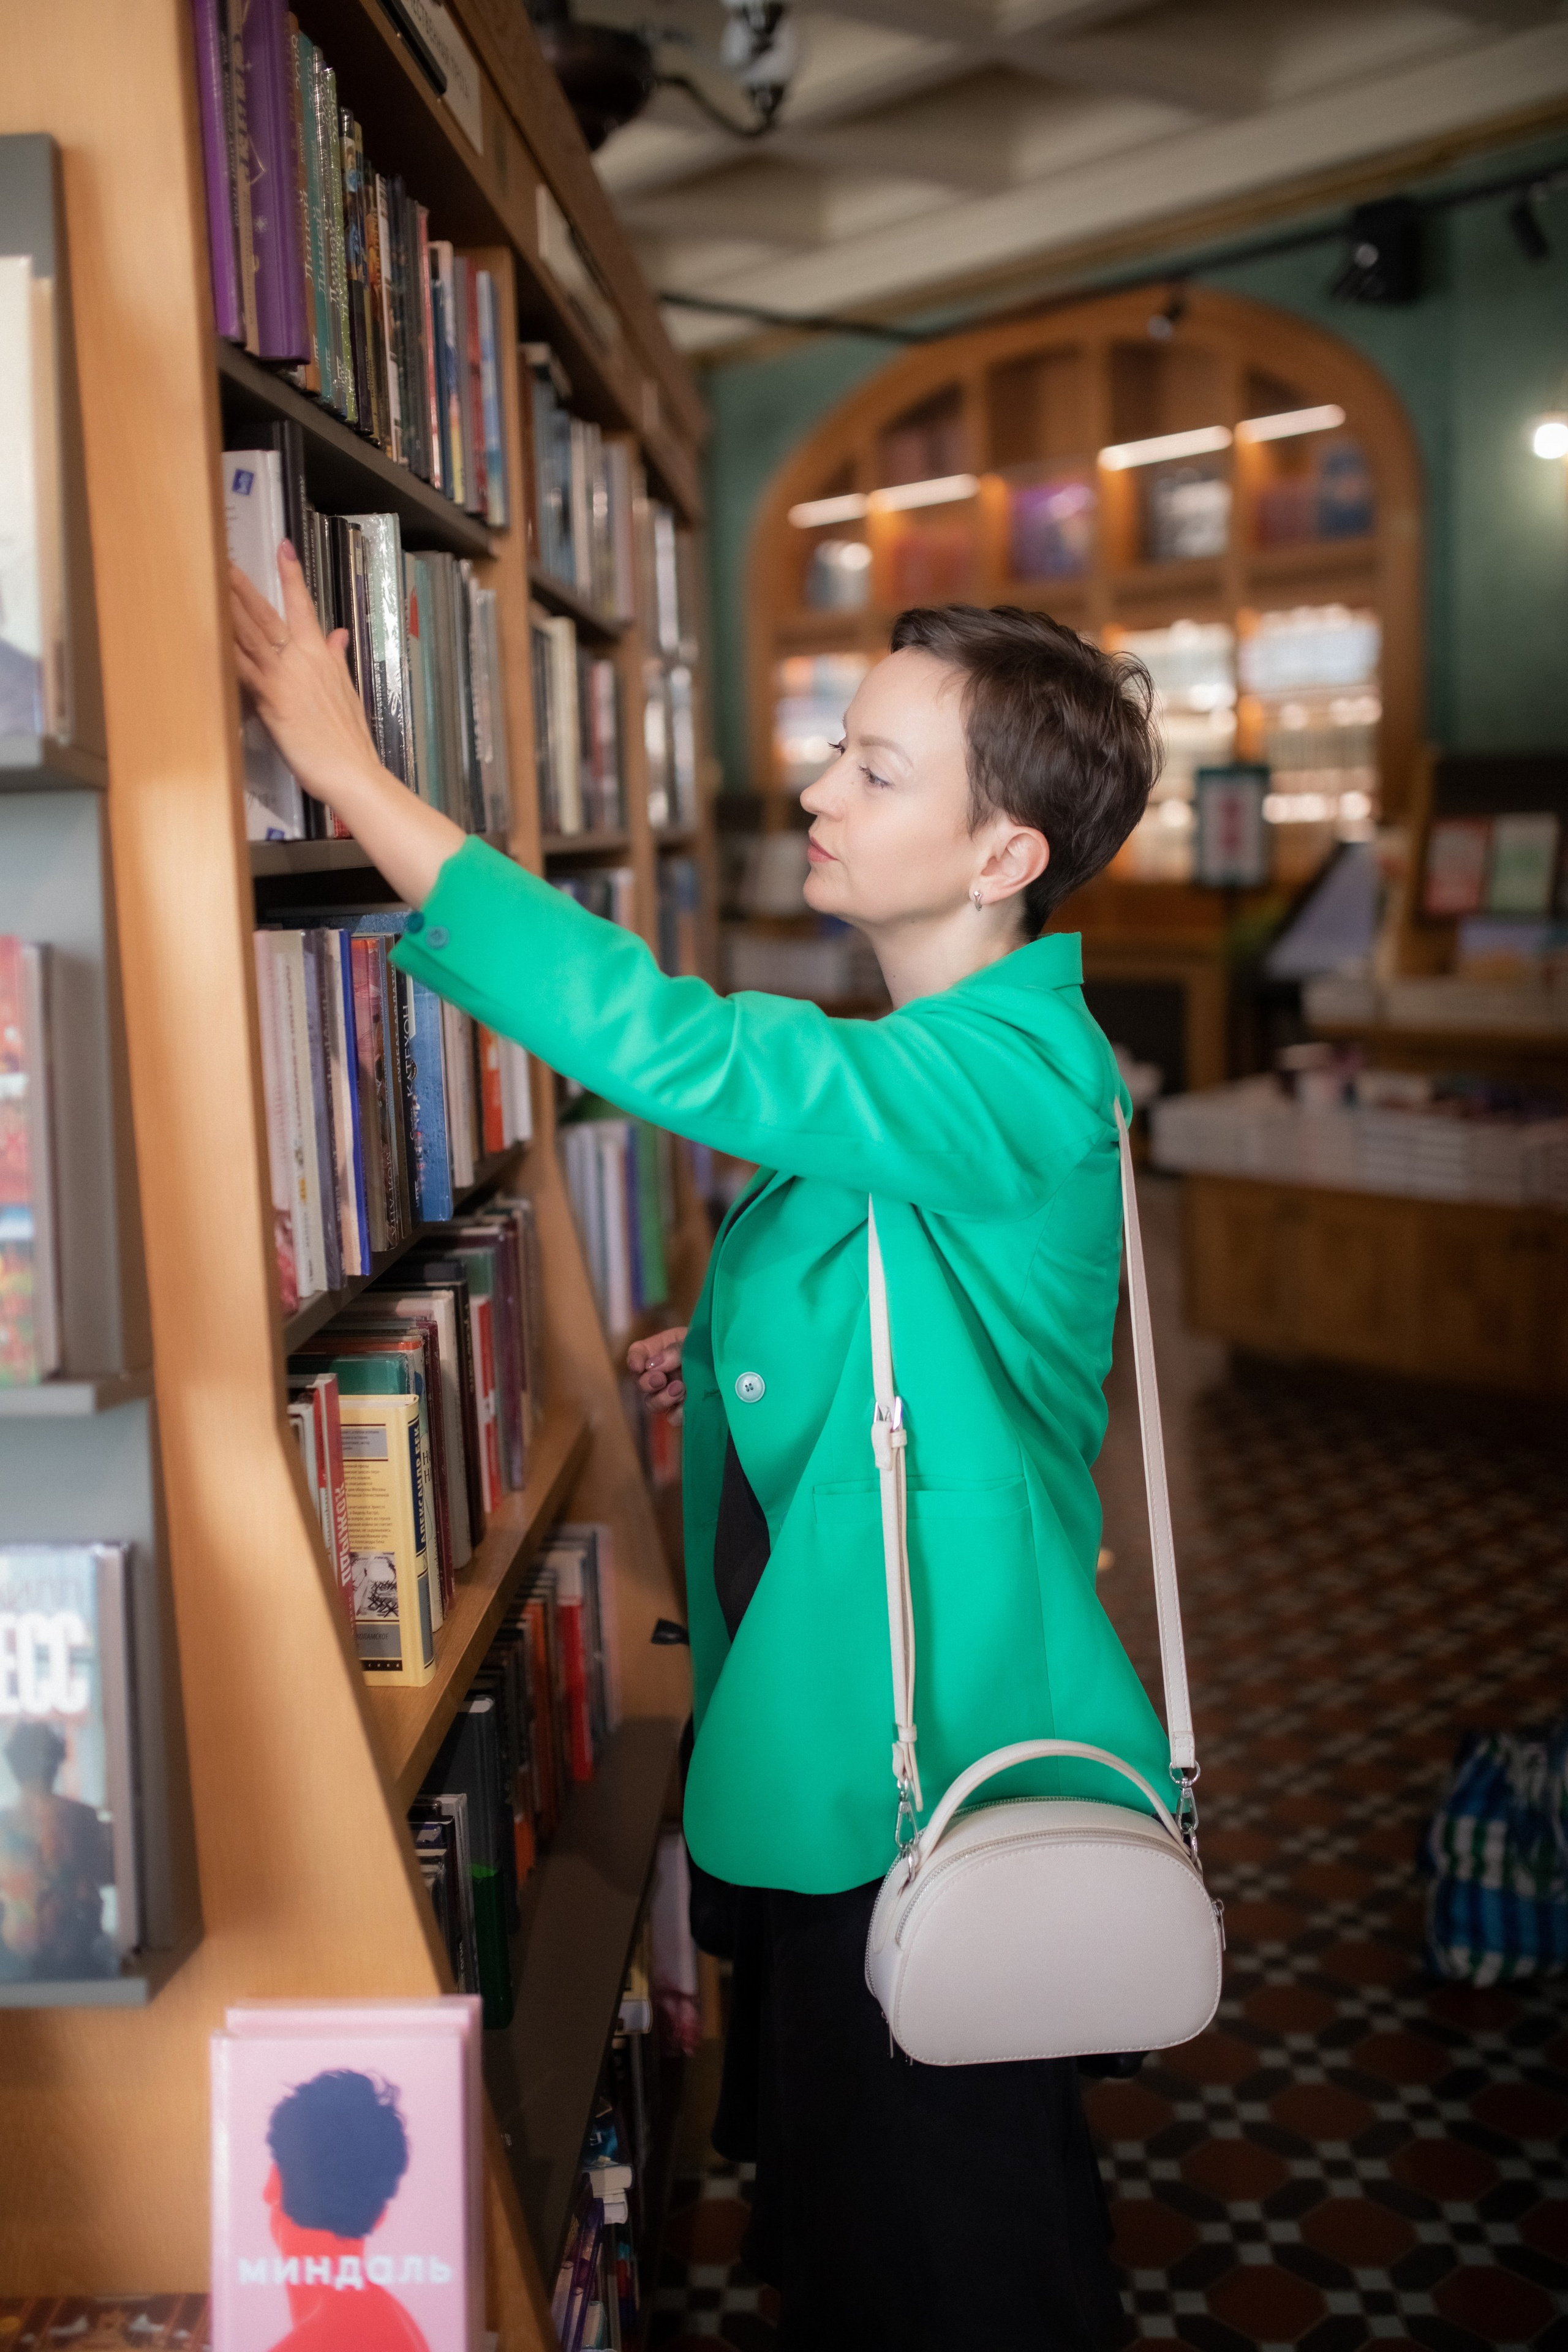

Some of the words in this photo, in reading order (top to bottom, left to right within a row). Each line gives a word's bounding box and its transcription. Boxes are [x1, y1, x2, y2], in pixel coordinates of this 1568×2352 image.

[299, 190, 314, 286] Лицей
[312, 206, 325, 295] Лицей
[334, 1482, 352, 1586] ПРЫЖОК
